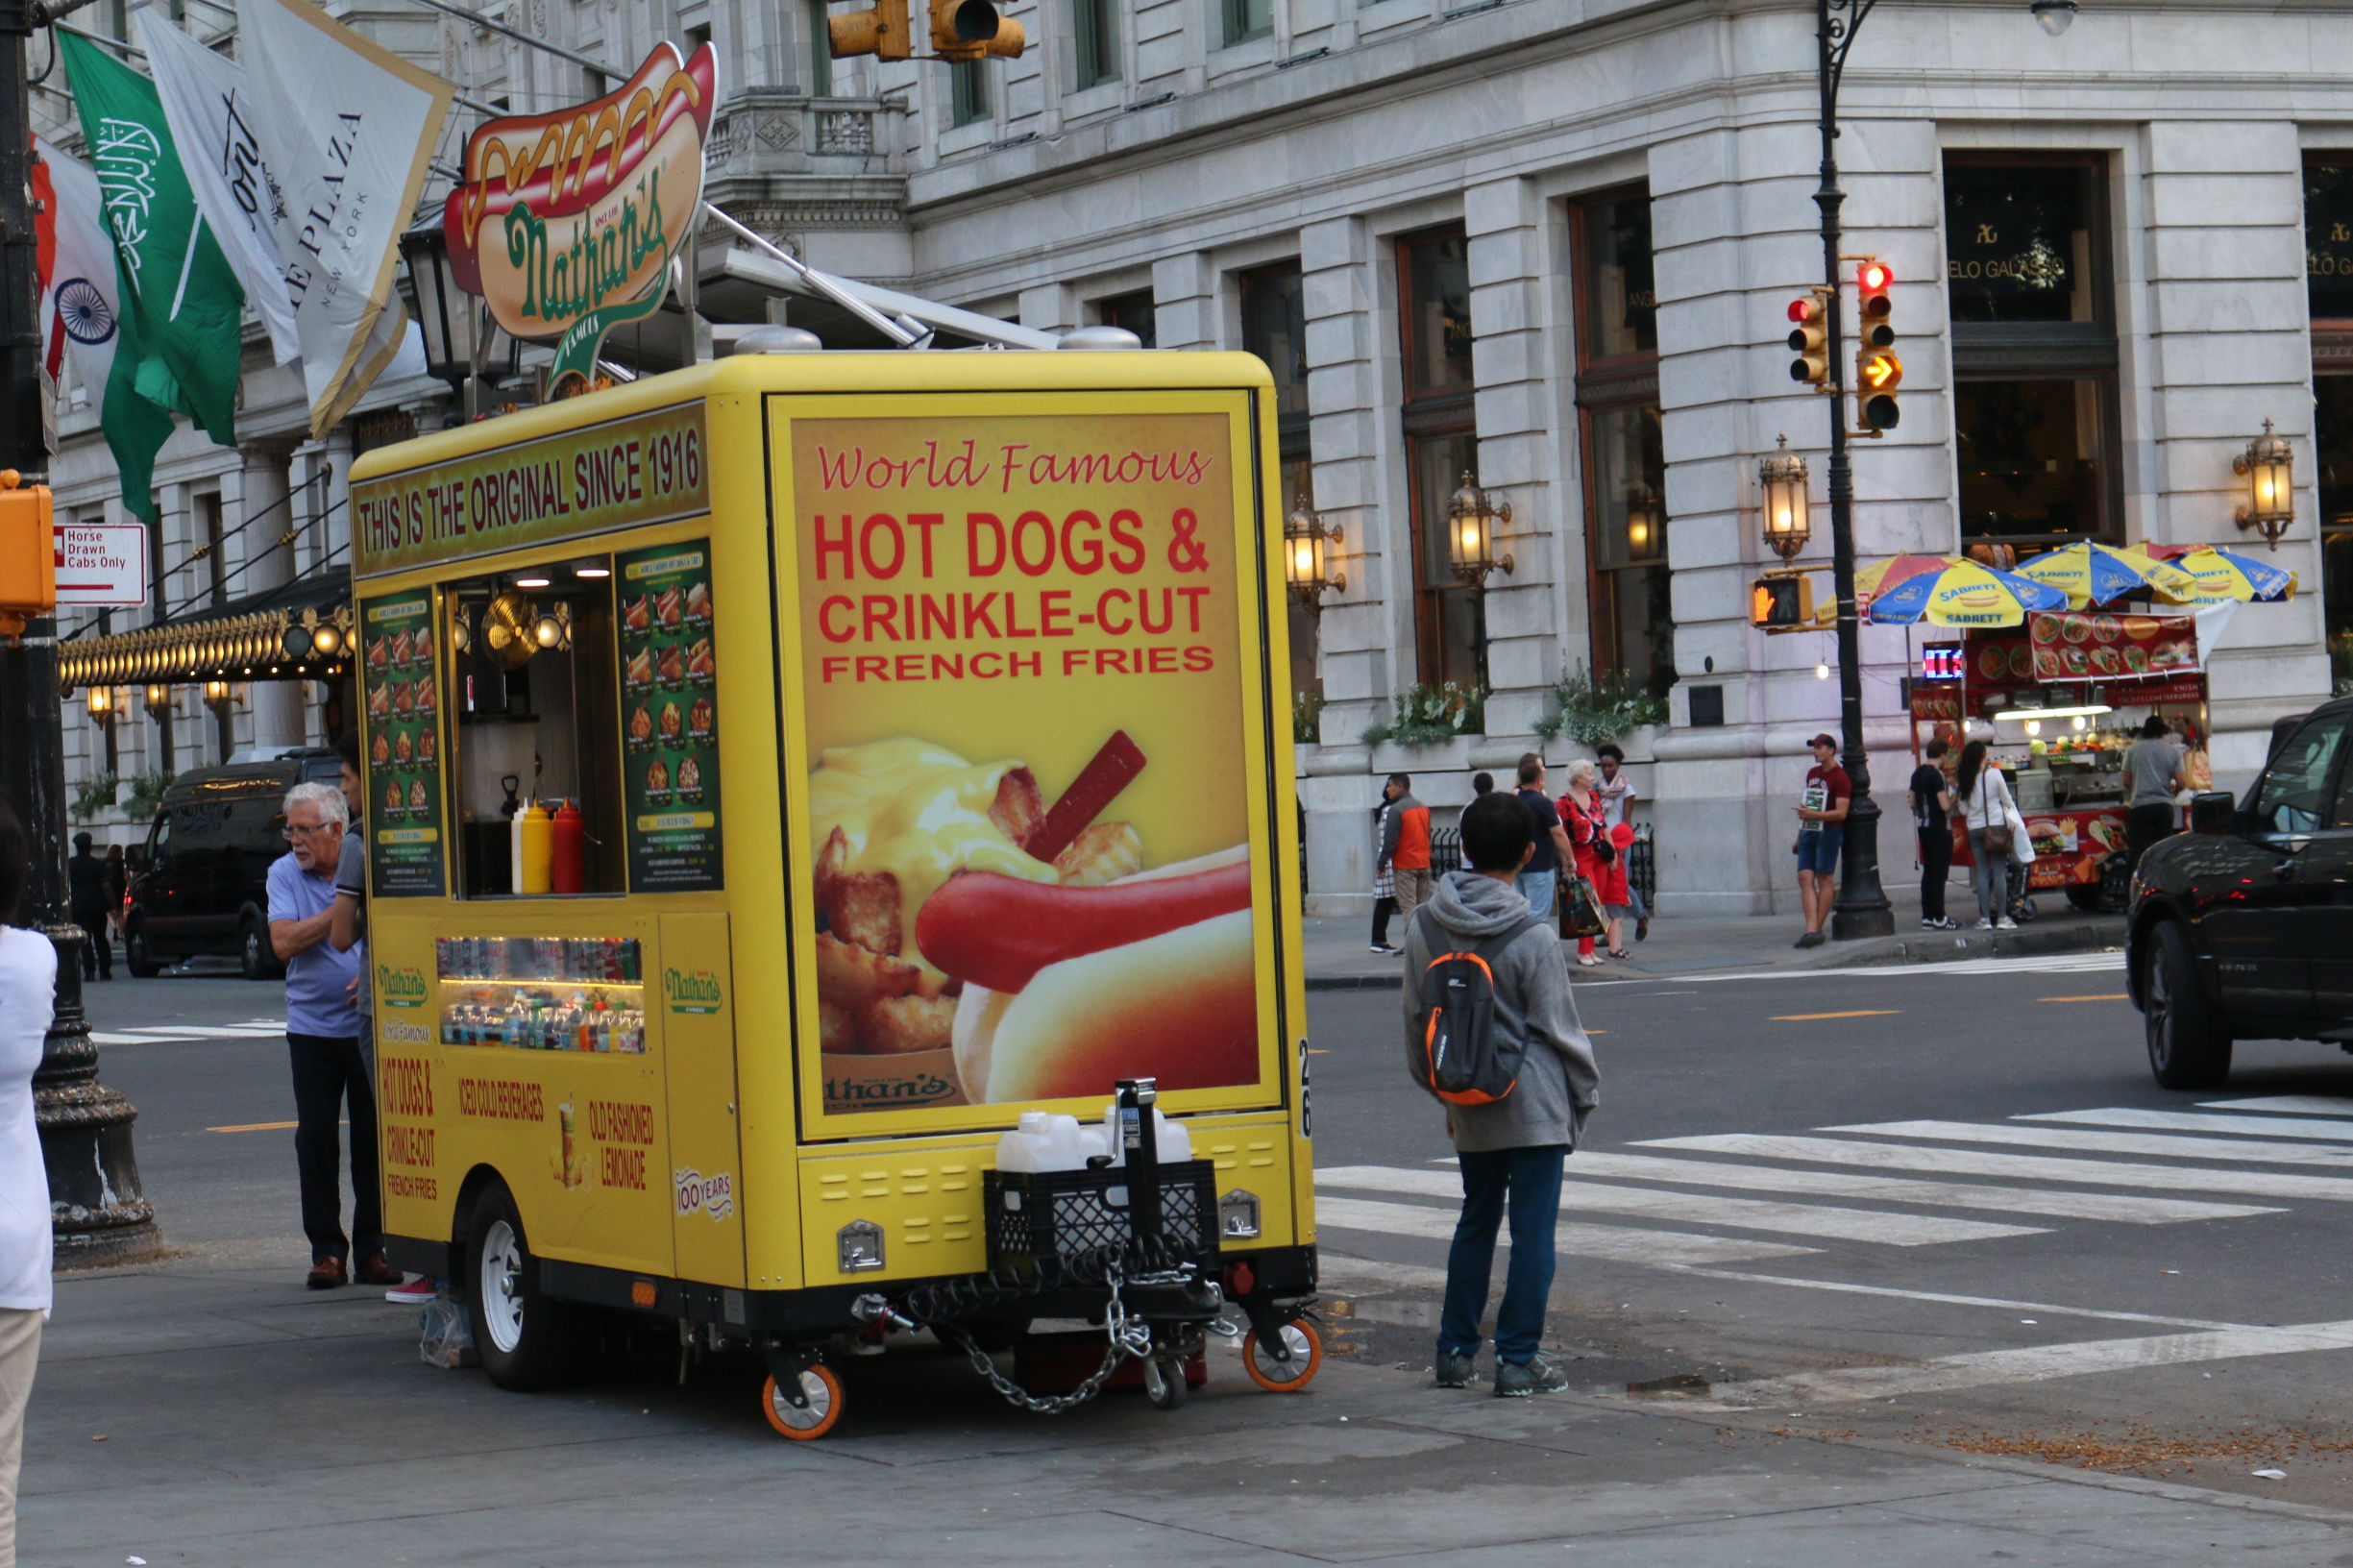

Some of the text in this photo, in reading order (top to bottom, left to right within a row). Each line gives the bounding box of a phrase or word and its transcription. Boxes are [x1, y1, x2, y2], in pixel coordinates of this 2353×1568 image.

[297, 112, 362, 257] PLAZA
[321, 191, 369, 308] NEW YORK
[504, 164, 668, 322] Nathan's
[1985, 257, 2065, 279] GALASSO
[564, 314, 600, 357] FAMOUS
[817, 438, 1213, 493] World Famous
[359, 429, 699, 554] THIS IS THE ORIGINAL SINCE 1916
[68, 530, 103, 542] Horse
[68, 543, 106, 554] Drawn
[814, 506, 1211, 581] HOT DOGS &
[68, 556, 126, 570] Cabs Only
[1939, 583, 1998, 602] SABRETT
[819, 586, 1211, 644] CRINKLE-CUT
[1946, 613, 2003, 624] SABRETT
[821, 645, 1215, 684] FRENCH FRIES
[397, 1058, 425, 1116] DOGS
[425, 1060, 434, 1117] &
[458, 1077, 545, 1122] ICED COLD BEVERAGES
[589, 1100, 654, 1145] OLD FASHIONED
[386, 1125, 435, 1167] CRINKLE-CUT
[387, 1173, 437, 1201] FRENCH FRIES
[601, 1147, 647, 1191] LEMONADE
[677, 1175, 730, 1212] 100 YEARS
